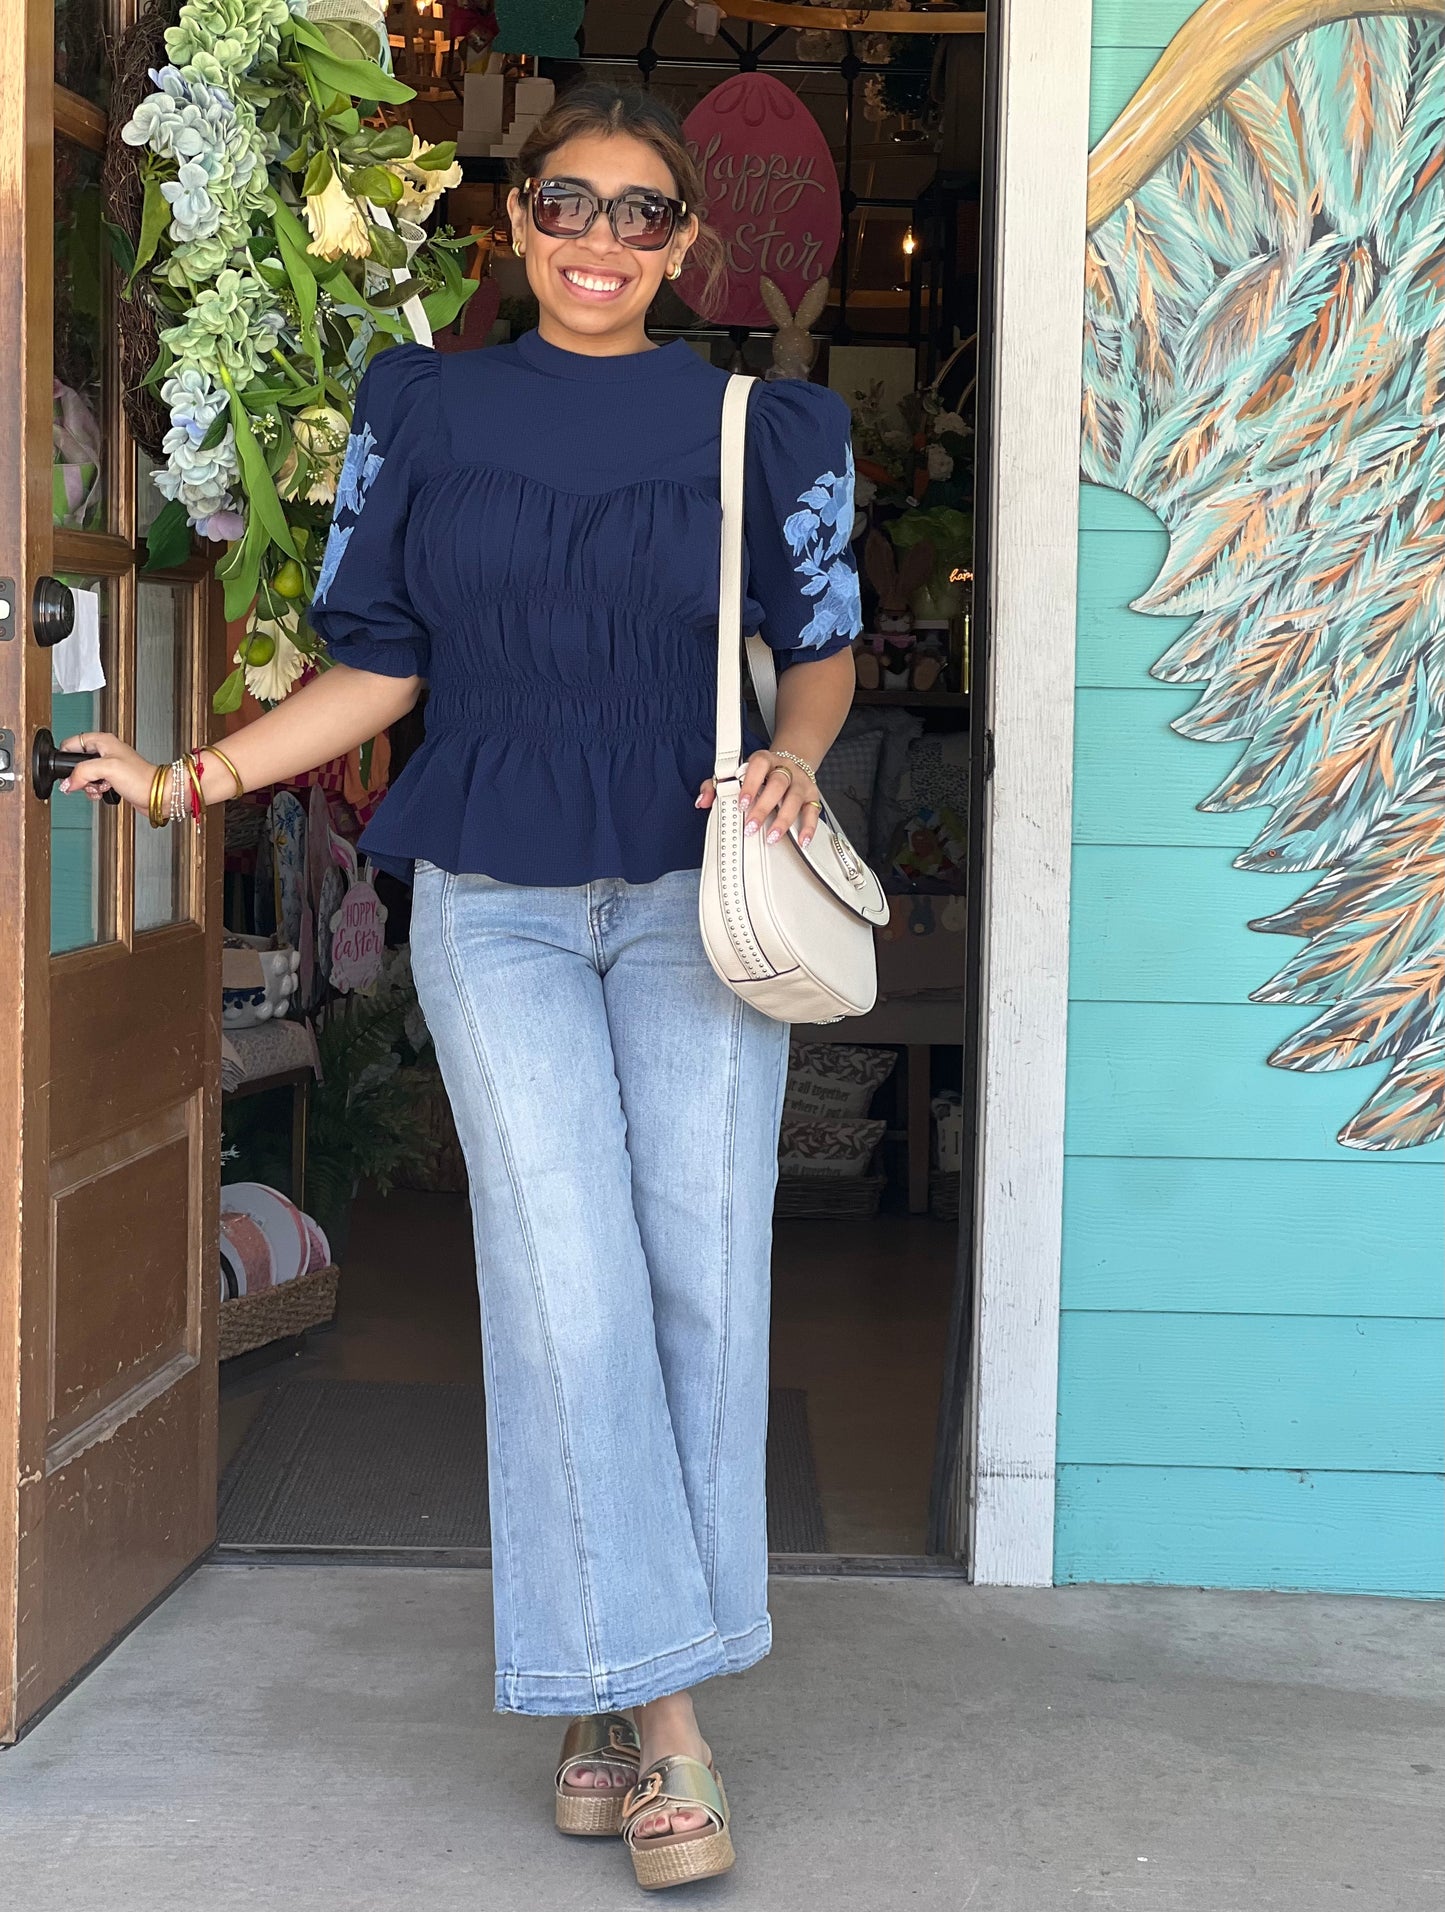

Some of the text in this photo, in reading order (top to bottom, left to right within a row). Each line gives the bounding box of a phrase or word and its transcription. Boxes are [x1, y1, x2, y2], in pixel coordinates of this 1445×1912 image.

[346, 901, 377, 929] HOPPY
[798, 1081, 811, 1095] all
[811, 1085, 850, 1102] together
[791, 1100, 818, 1114] where
